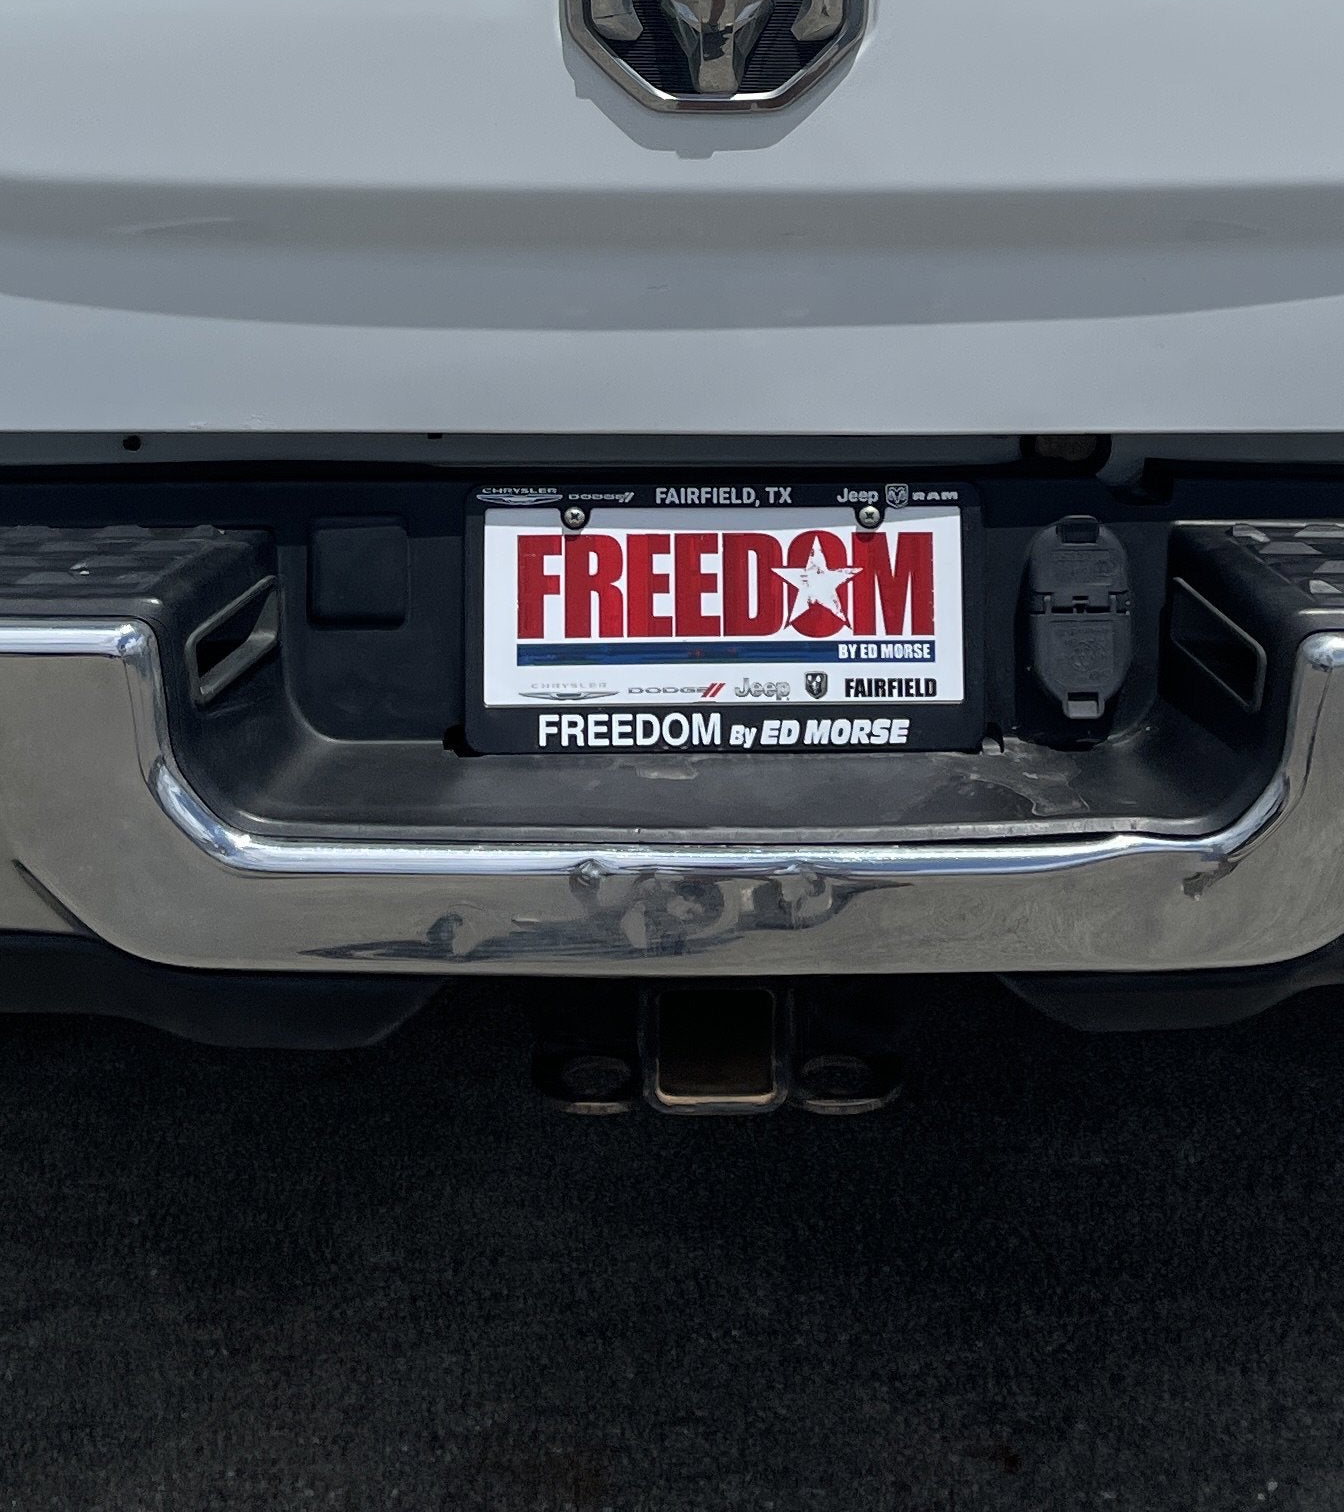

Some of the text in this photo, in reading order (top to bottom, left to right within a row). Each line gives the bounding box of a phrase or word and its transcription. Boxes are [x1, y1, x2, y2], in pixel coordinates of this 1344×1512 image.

[655, 487, 792, 507] FAIRFIELD, TX
[836, 487, 879, 504] Jeep
[912, 491, 958, 501] RAM
[517, 531, 935, 638] FREEDOM
[838, 643, 931, 659] BY ED MORSE
[734, 677, 791, 701] Jeep
[844, 677, 937, 698] FAIRFIELD
[538, 712, 910, 749] FREEDOM By ED MORSE
